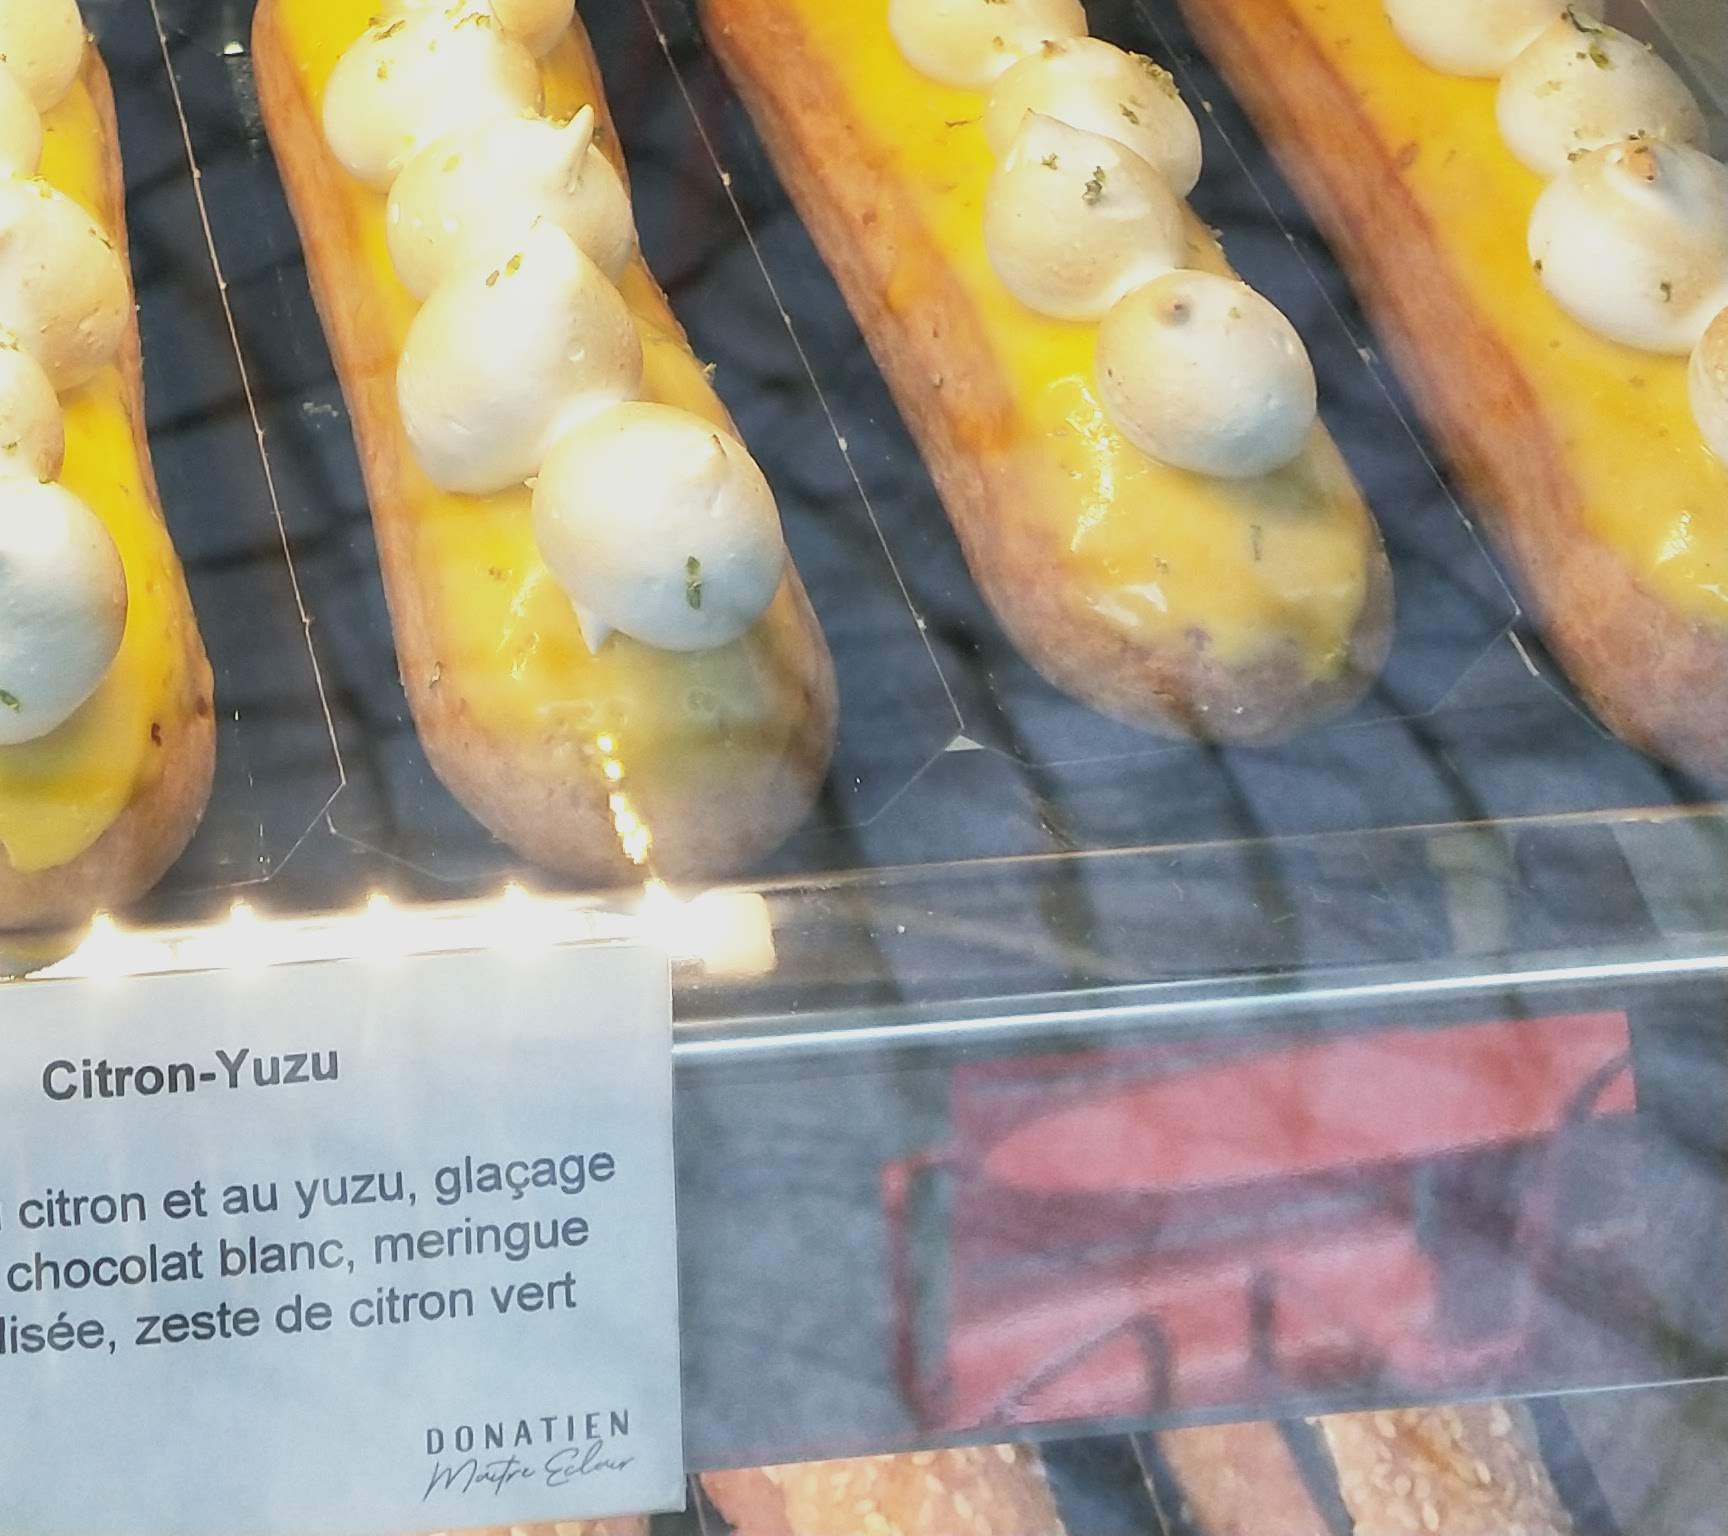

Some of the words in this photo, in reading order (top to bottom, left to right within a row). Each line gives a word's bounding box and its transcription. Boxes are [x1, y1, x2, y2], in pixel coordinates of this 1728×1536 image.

[41, 1046, 339, 1102] Citron-Yuzu
[17, 1183, 148, 1228] citron
[162, 1181, 209, 1220] et
[223, 1178, 279, 1215] au
[295, 1170, 417, 1220] yuzu,
[434, 1150, 616, 1205] glaçage
[6, 1239, 204, 1292] chocolat
[219, 1234, 355, 1276] blanc,
[373, 1215, 589, 1263] meringue
[134, 1302, 262, 1347] zeste
[274, 1292, 334, 1334] de
[349, 1279, 475, 1326] citron
[489, 1270, 576, 1315] vert
[426, 1409, 629, 1454] DONATIEN
